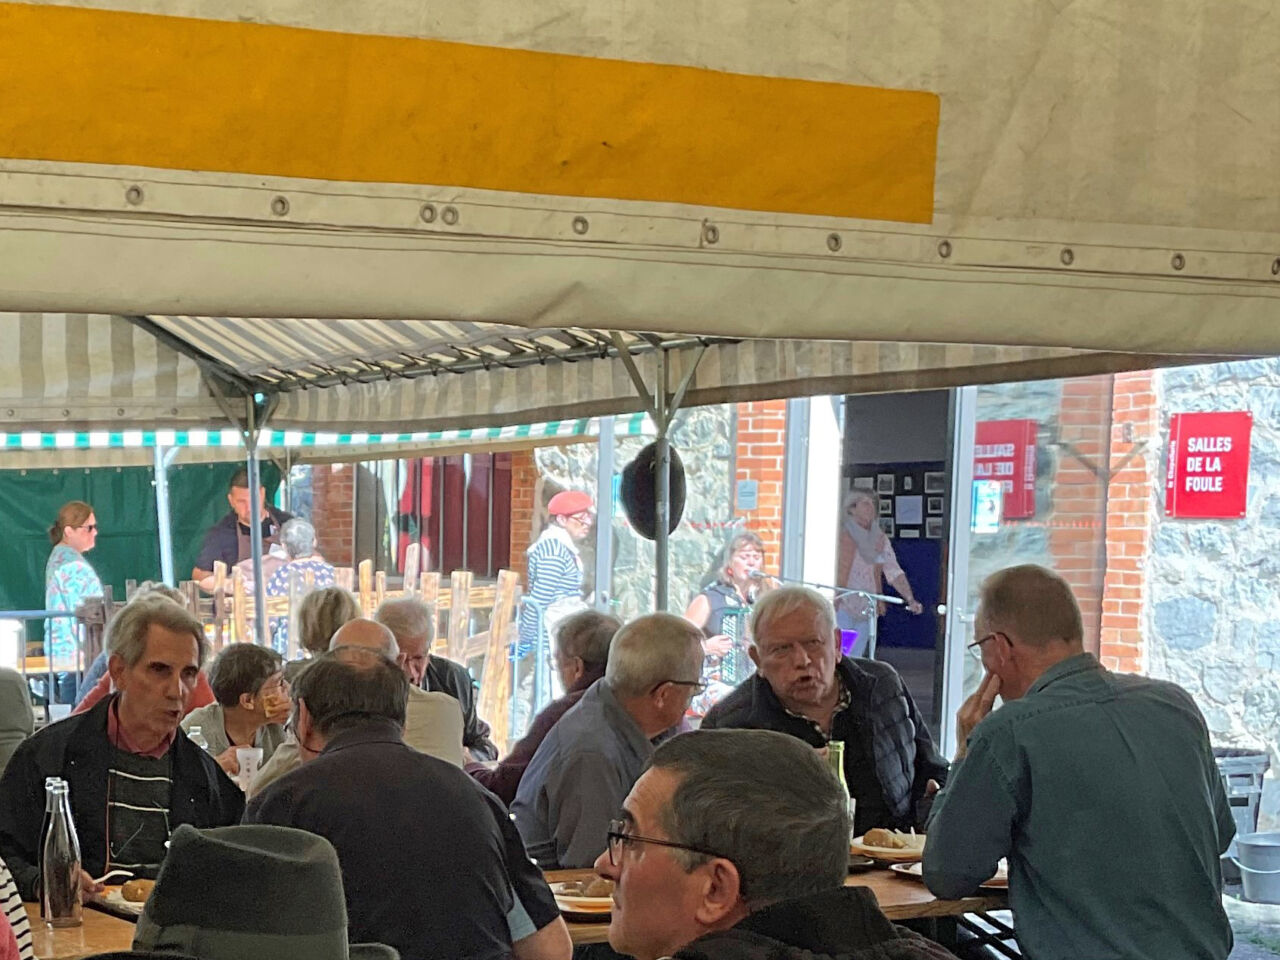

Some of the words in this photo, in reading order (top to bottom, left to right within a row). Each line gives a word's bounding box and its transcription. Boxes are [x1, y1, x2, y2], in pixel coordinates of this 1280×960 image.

[1187, 437, 1232, 452] SALLES
[1186, 457, 1203, 472] DE
[1205, 457, 1222, 472] LA
[1185, 476, 1223, 492] FOULE
